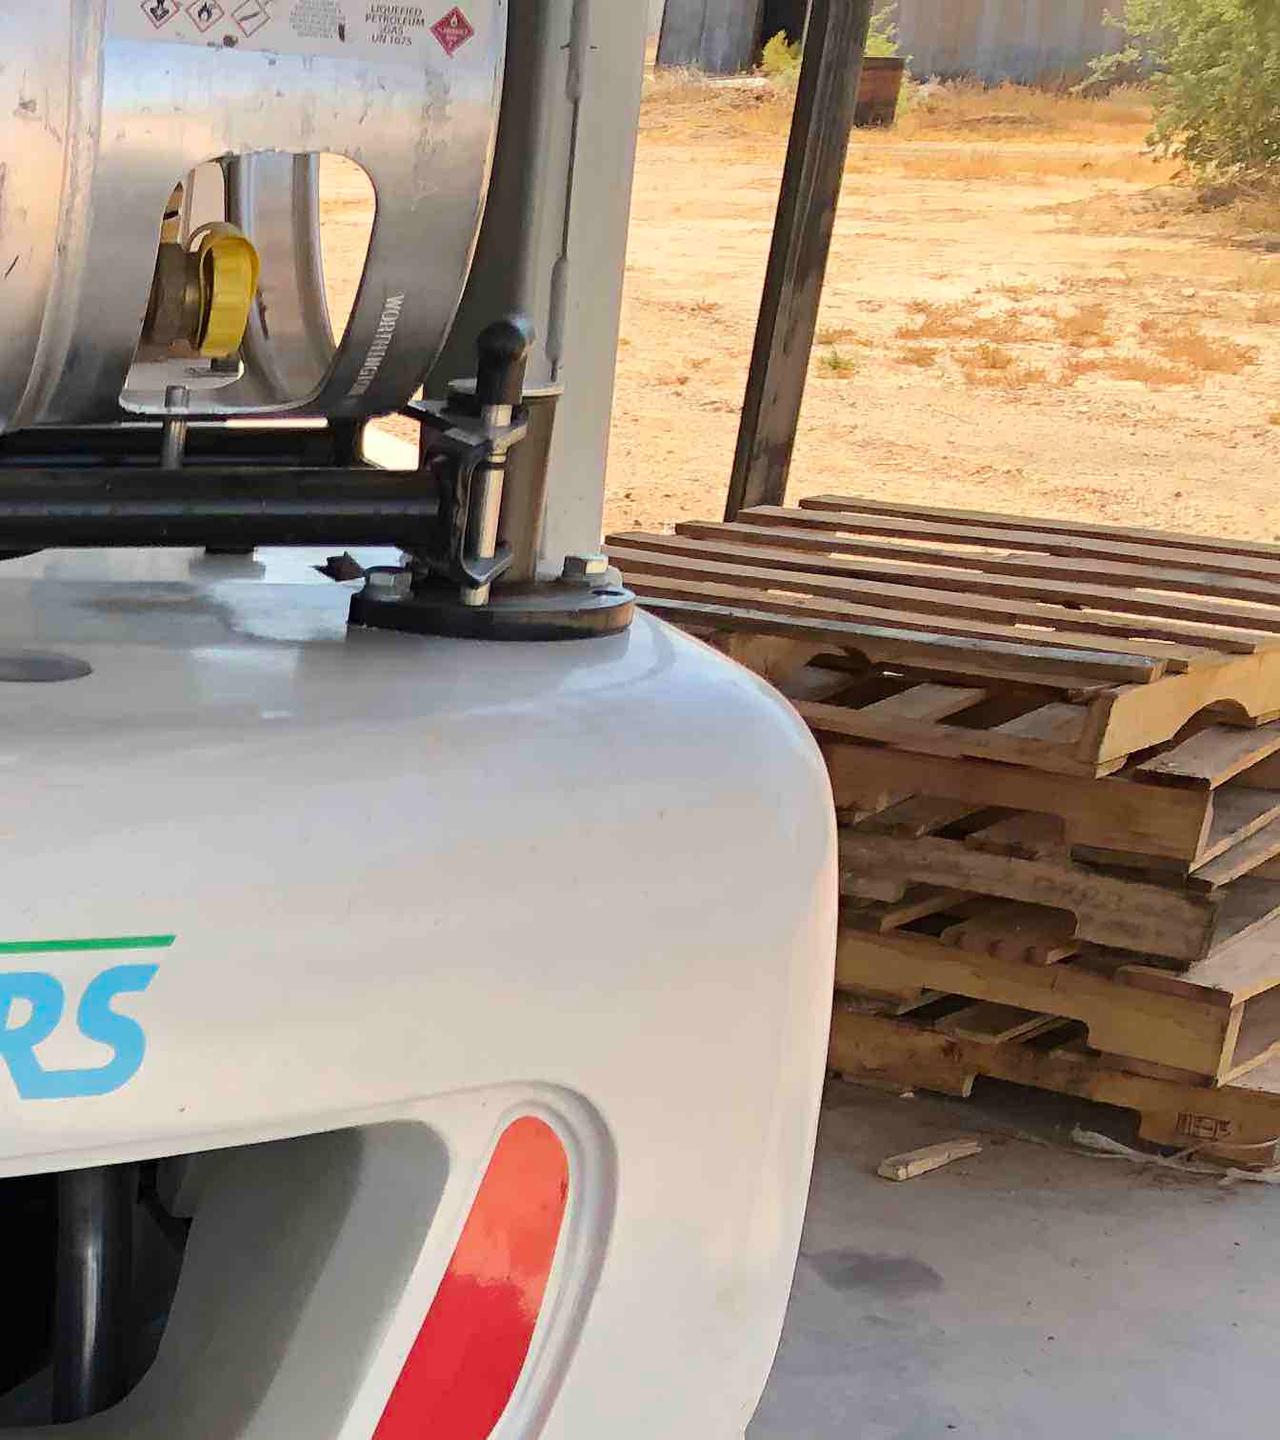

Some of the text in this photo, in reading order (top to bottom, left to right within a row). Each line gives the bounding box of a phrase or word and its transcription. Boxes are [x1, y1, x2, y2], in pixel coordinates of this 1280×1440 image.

[371, 4, 423, 16] LIQUEFIED
[365, 13, 425, 27] PETROLEUM
[383, 25, 404, 35] GAS
[371, 34, 387, 44] UN
